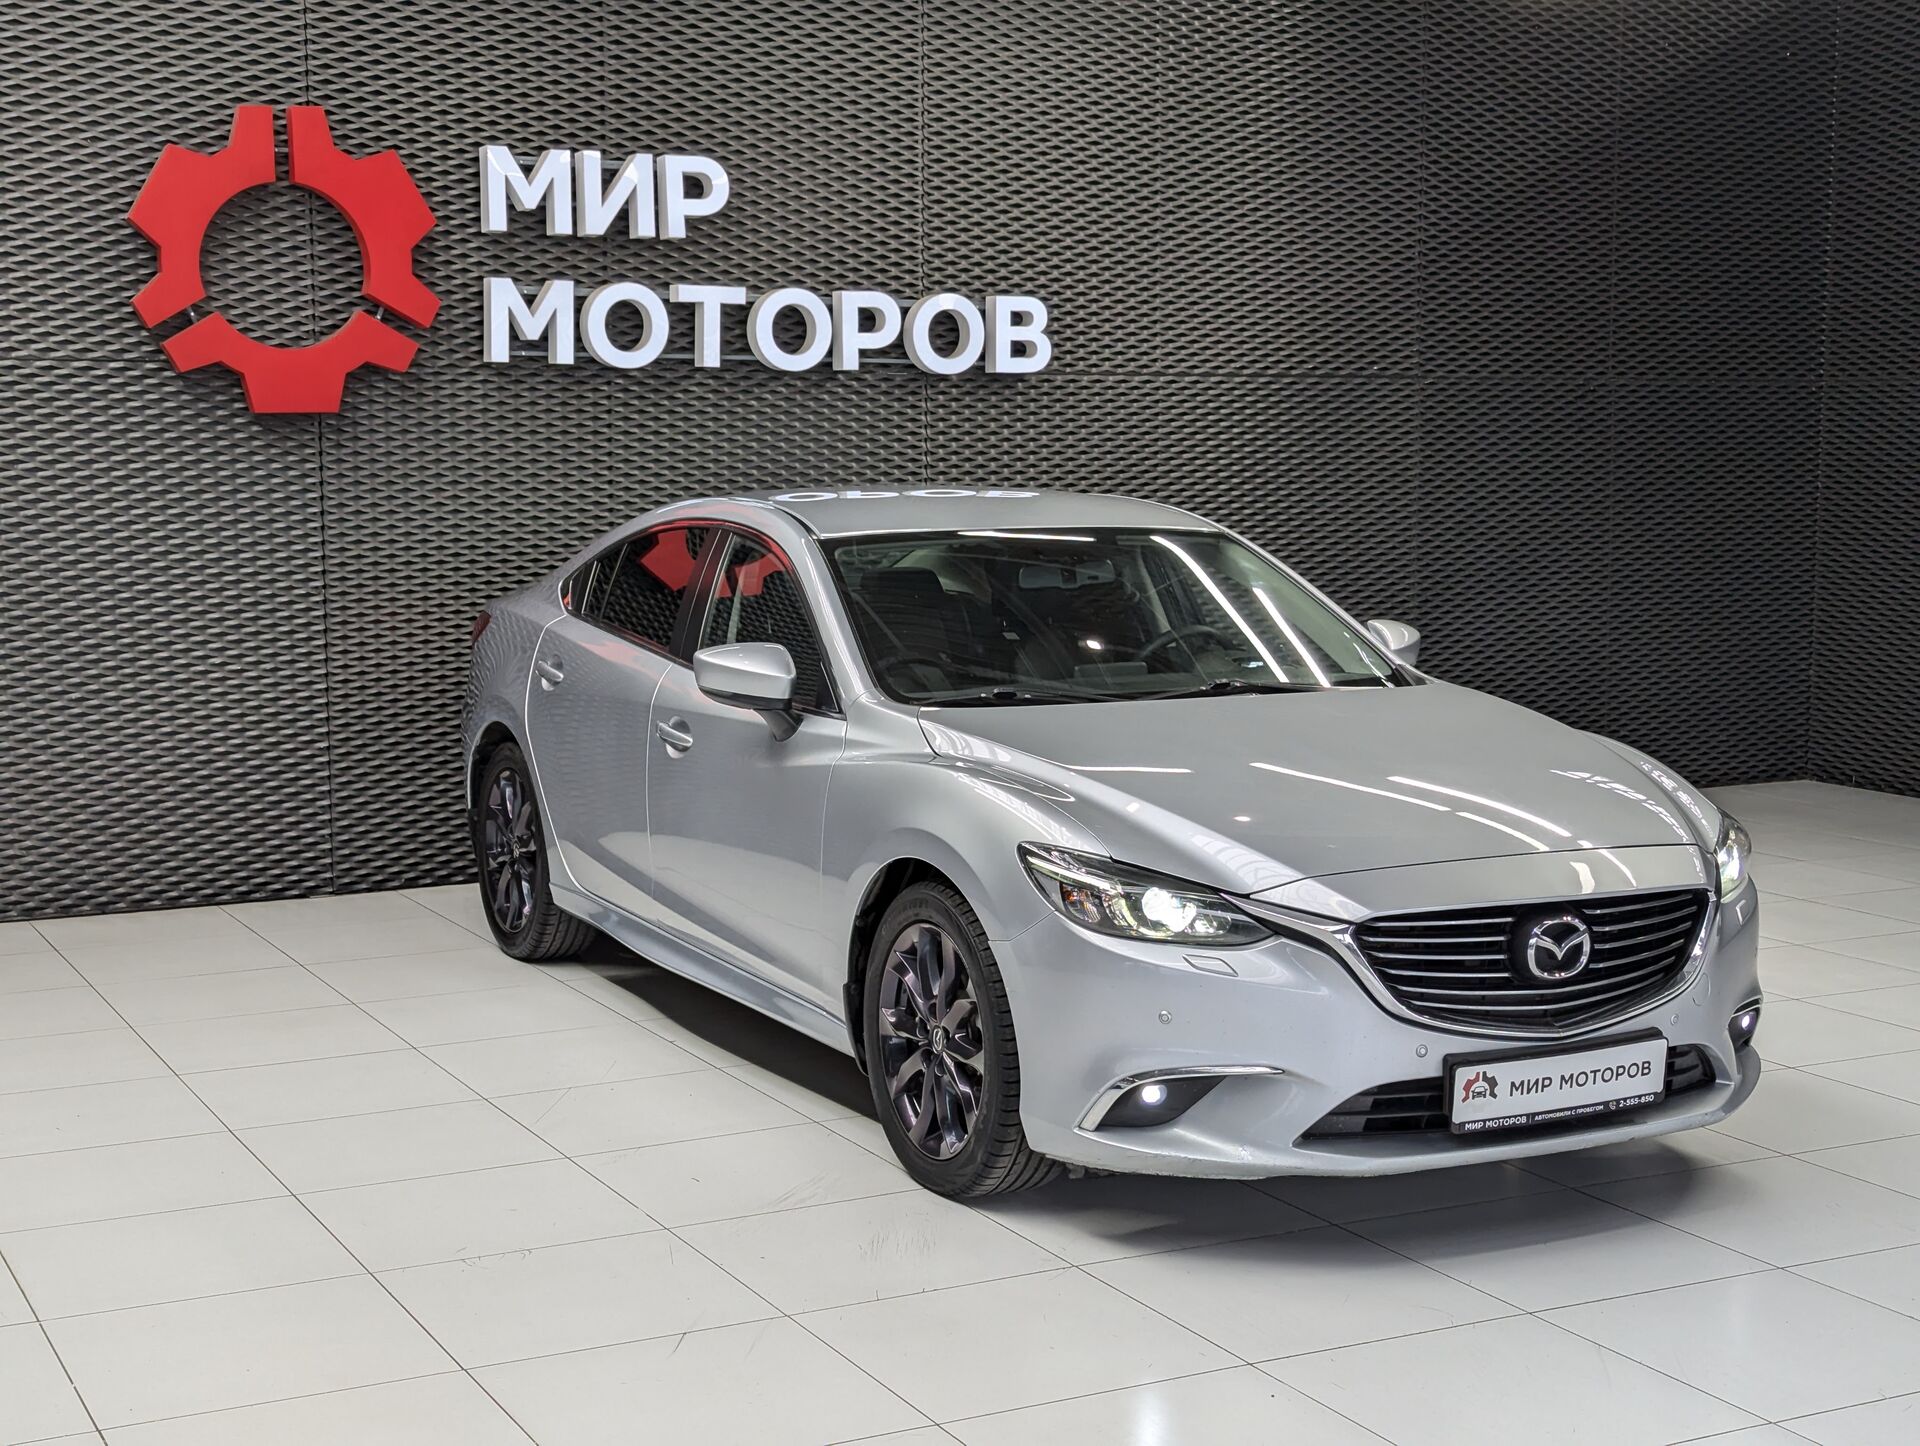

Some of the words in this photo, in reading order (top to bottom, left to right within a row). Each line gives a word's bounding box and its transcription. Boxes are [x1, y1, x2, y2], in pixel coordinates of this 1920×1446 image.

[479, 144, 730, 240] МИР
[482, 277, 1053, 375] МОТОРОВ
[1509, 1076, 1553, 1097] МИР
[1559, 1060, 1652, 1091] МОТОРОВ
[1464, 1122, 1484, 1131] МИР
[1485, 1115, 1527, 1129] МОТОРОВ
[1534, 1109, 1571, 1121] АВТОМОБИЛИ
[1576, 1104, 1604, 1114] ПРОБЕГОМ
[1619, 1094, 1655, 1108] 2-555-850
